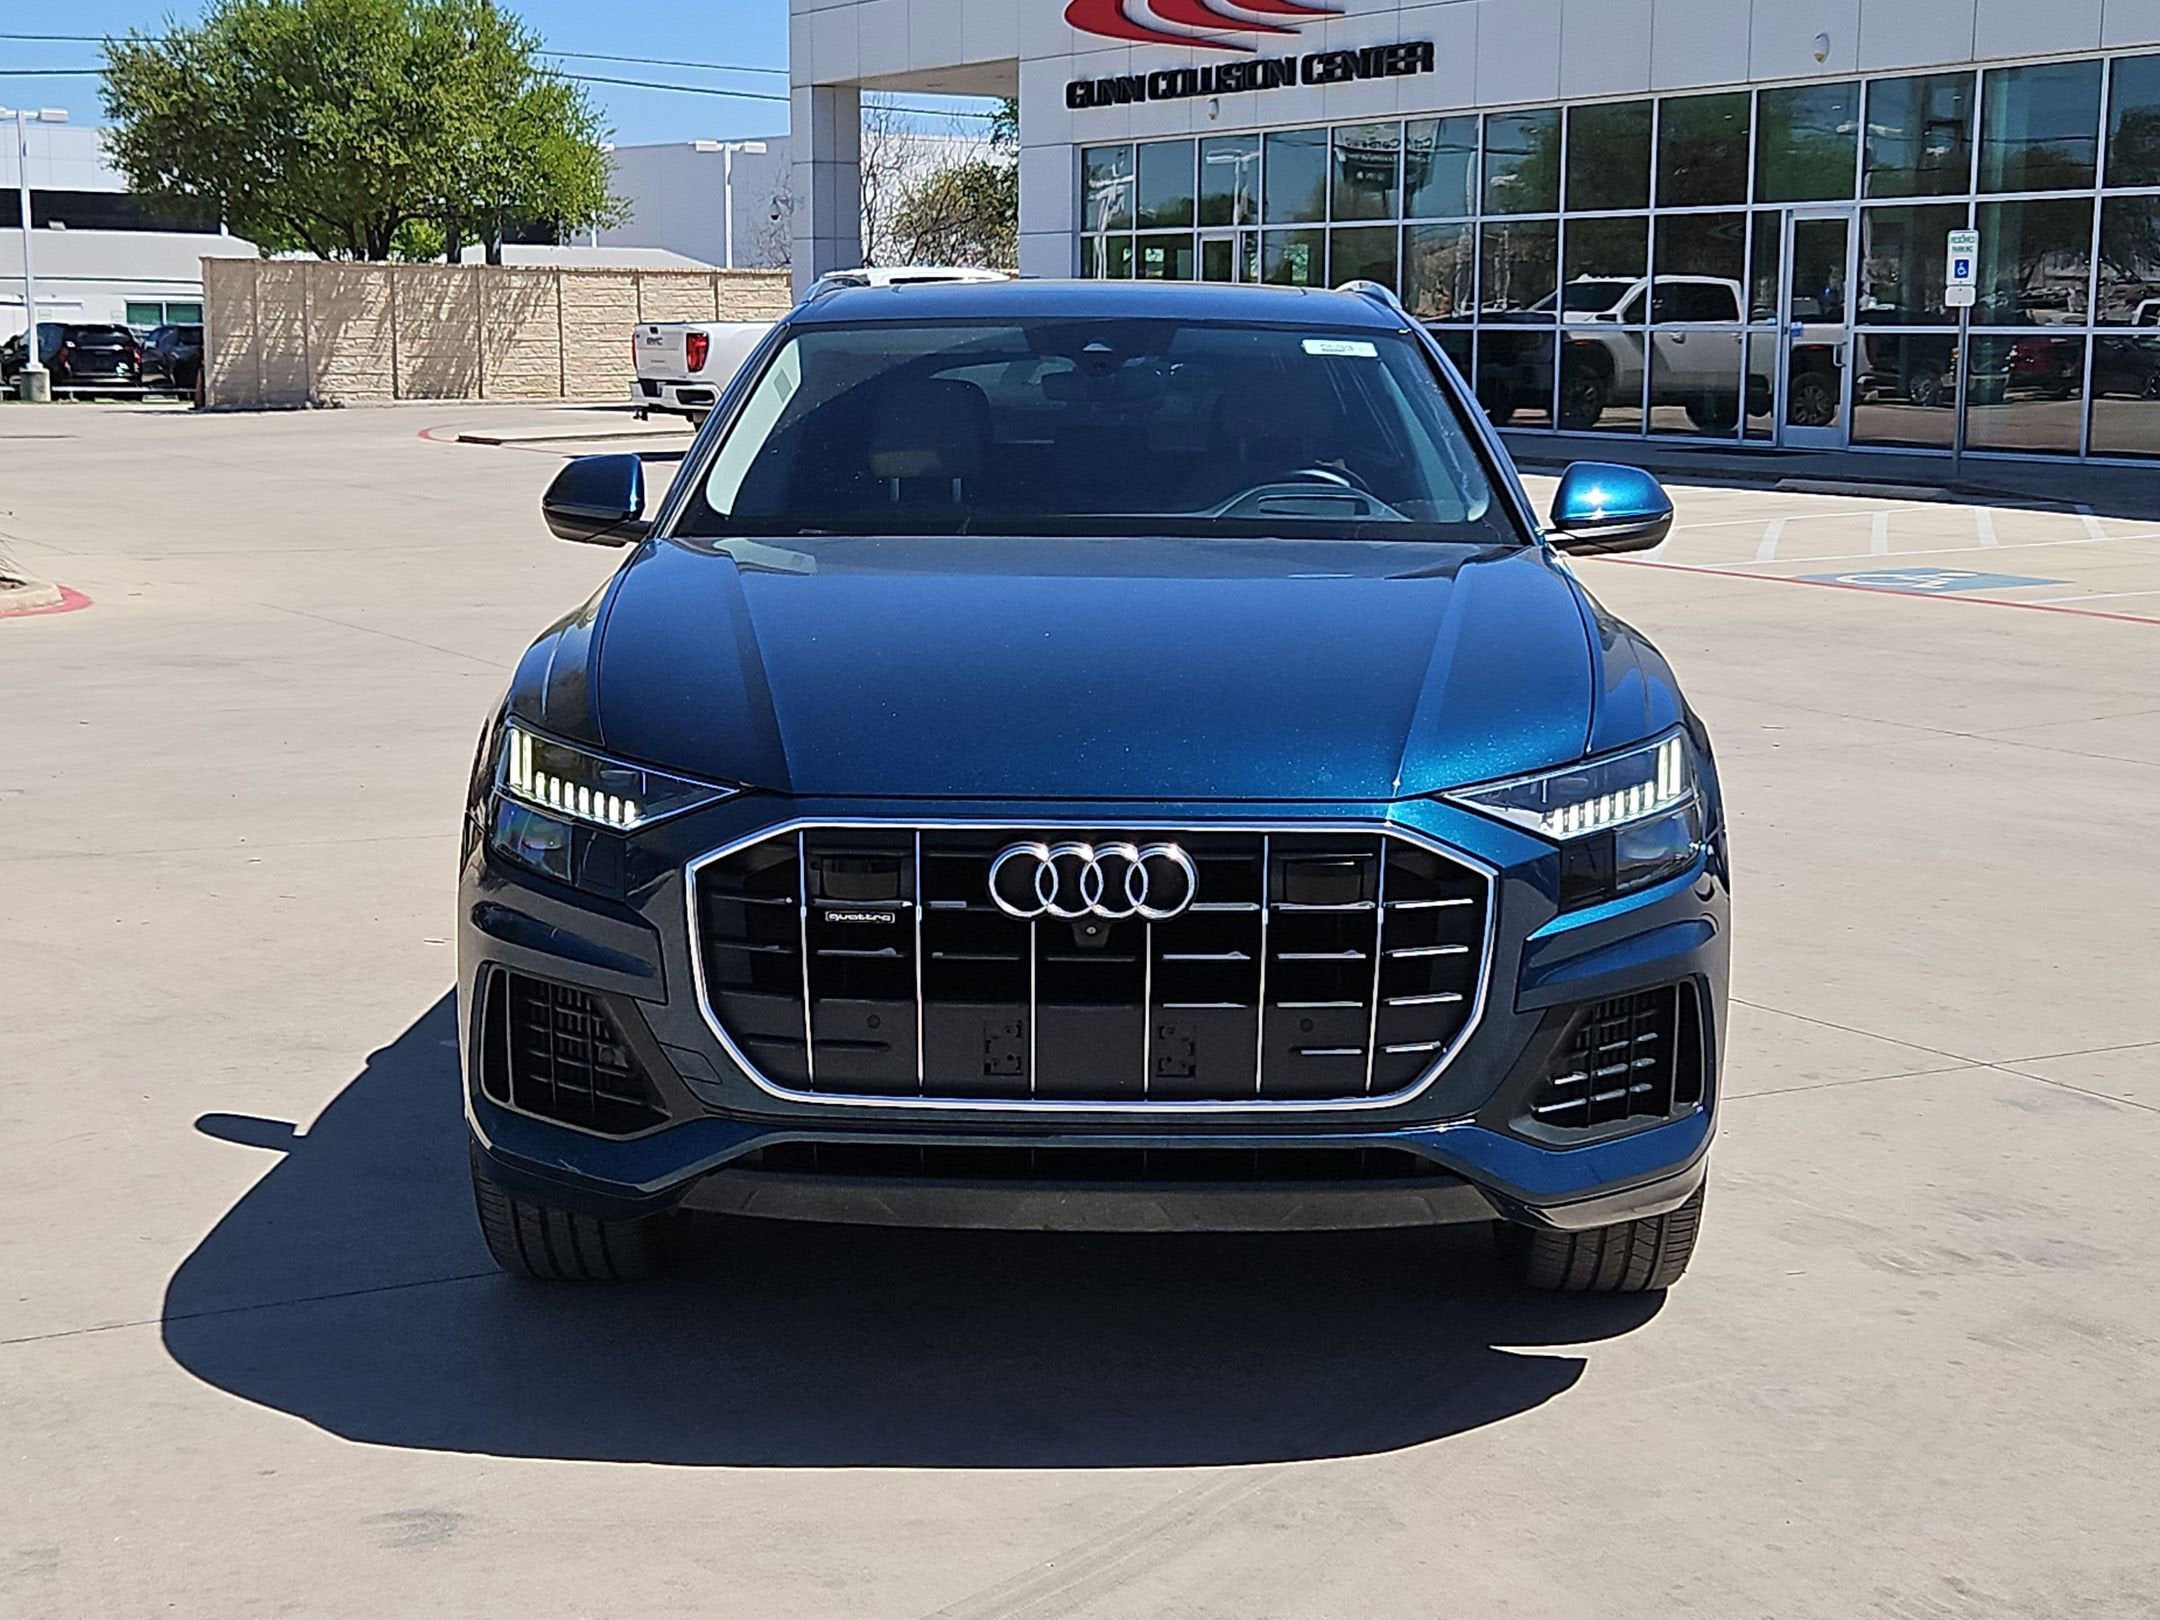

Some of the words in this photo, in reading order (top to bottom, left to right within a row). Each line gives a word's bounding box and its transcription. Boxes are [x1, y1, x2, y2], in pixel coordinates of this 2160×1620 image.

[1066, 75, 1146, 109] GUNN
[1148, 56, 1297, 100] COLLISION
[1301, 42, 1435, 85] CENTER
[828, 912, 892, 922] quattro
